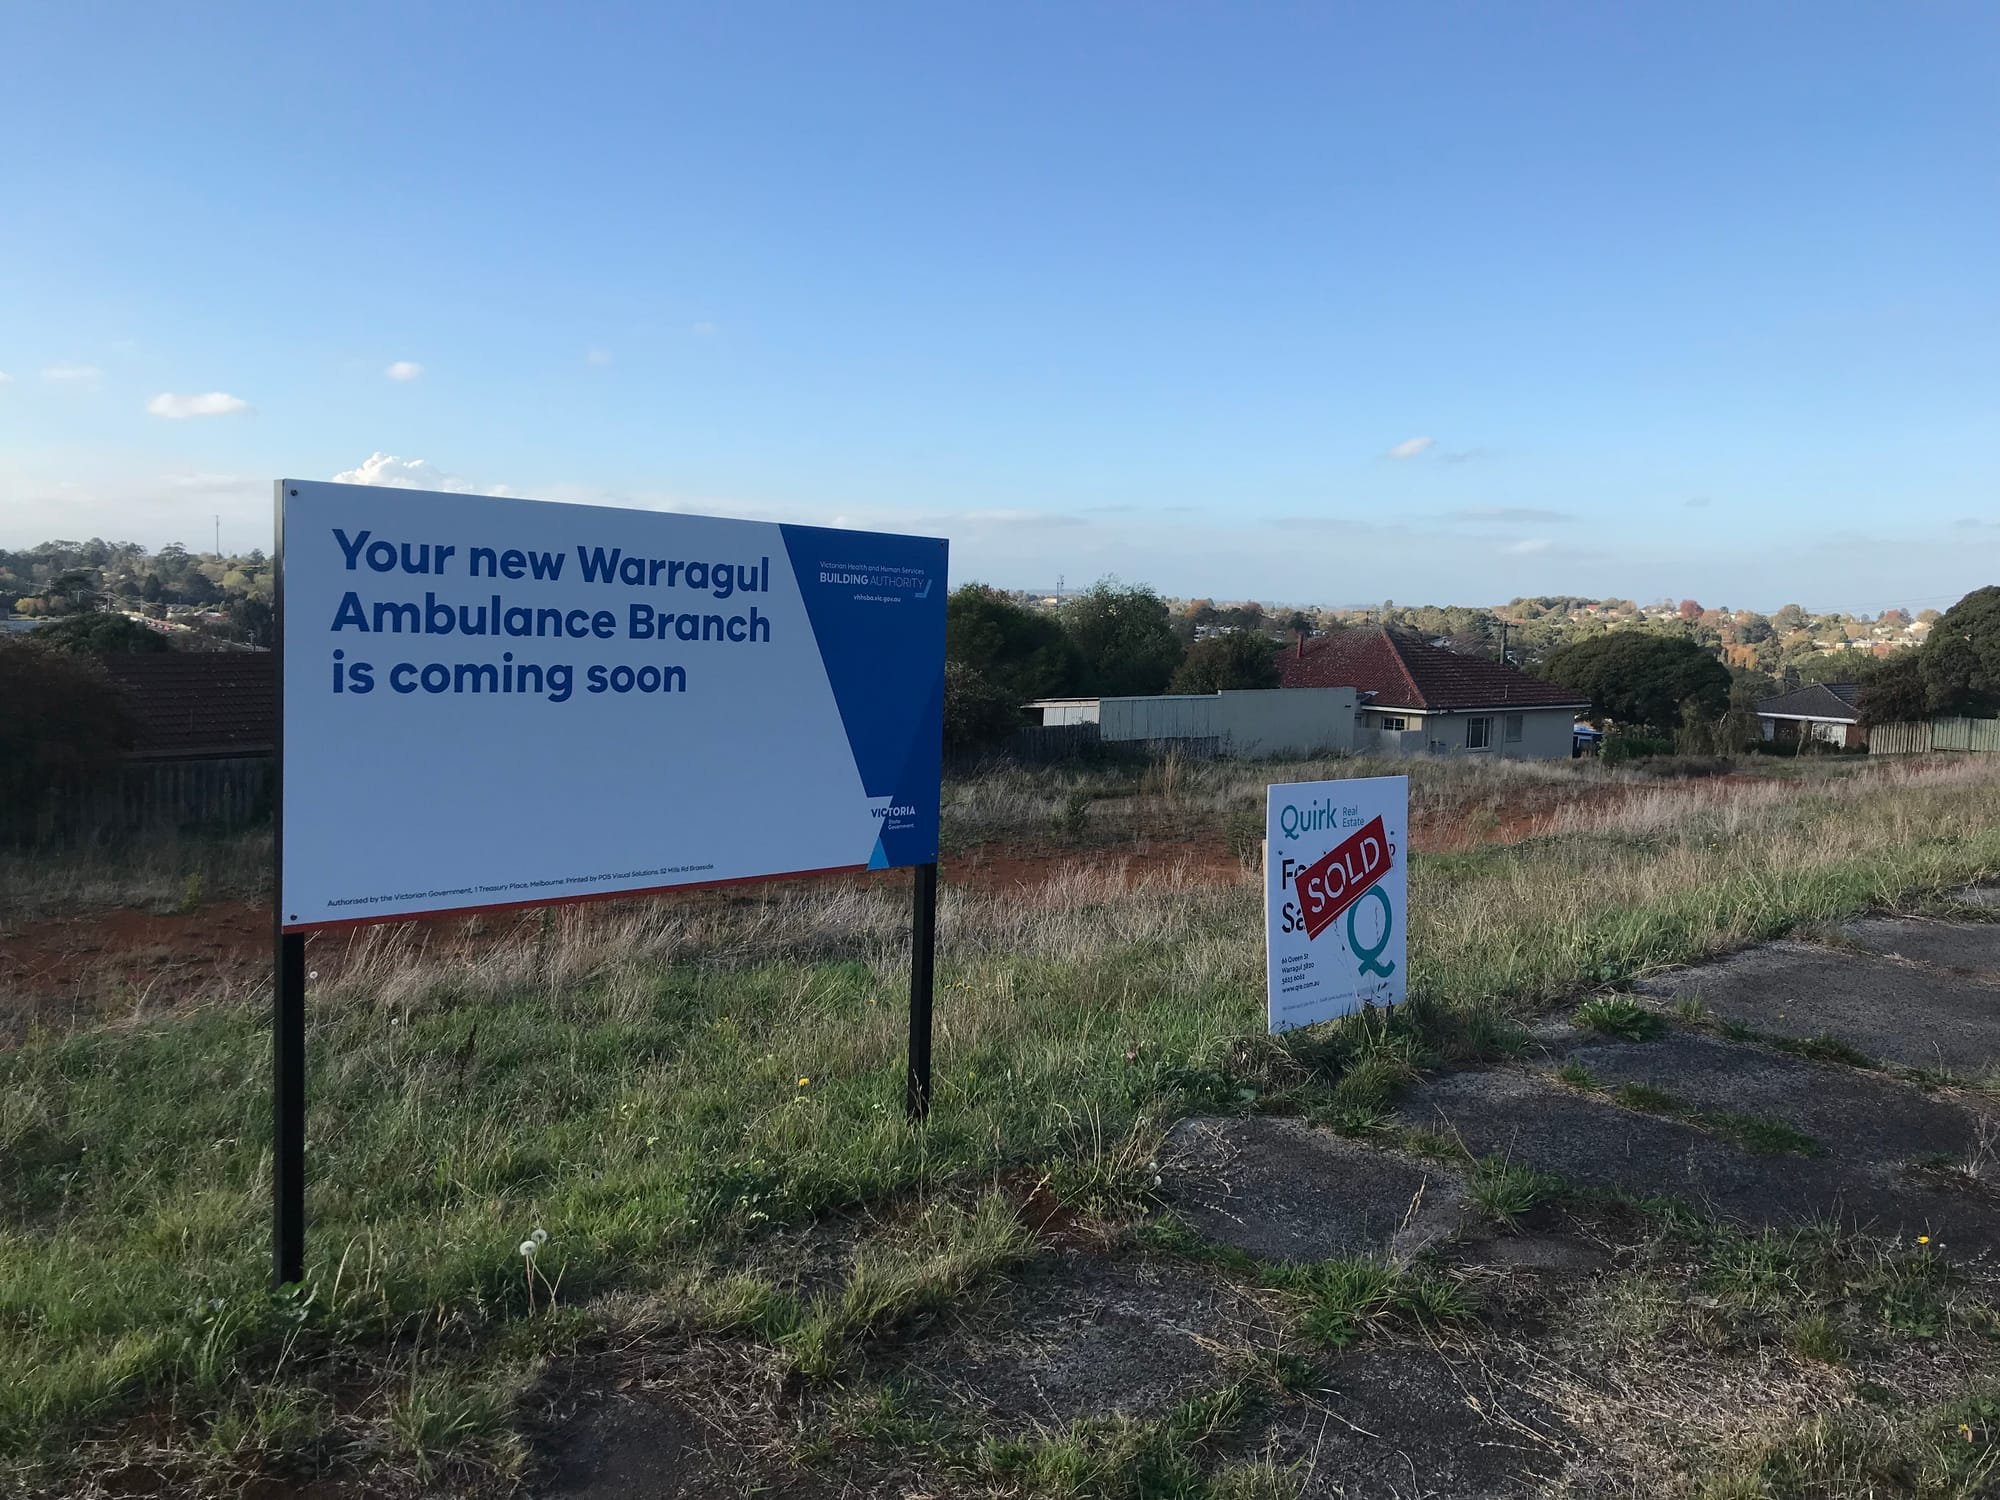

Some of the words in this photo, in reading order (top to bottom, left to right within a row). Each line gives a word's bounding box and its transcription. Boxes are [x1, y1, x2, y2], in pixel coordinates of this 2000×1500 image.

[332, 528, 455, 575] Your
[469, 545, 566, 582] new
[577, 545, 769, 599] Warragul
[820, 572, 869, 585] BUILDING
[870, 576, 924, 588] AUTHORITY
[868, 565, 879, 573] and
[330, 591, 617, 639] Ambulance
[628, 603, 771, 643] Branch
[332, 648, 376, 694] is
[389, 651, 574, 703] coming
[586, 663, 687, 693] soon
[871, 805, 916, 818] VICTORIA
[1280, 798, 1338, 841] Quirk
[1342, 805, 1359, 817] Real
[1342, 817, 1366, 828] Estate
[327, 897, 369, 907] Authorised
[369, 896, 379, 904] by
[394, 891, 428, 901] Victorian
[478, 883, 509, 893] Treasury
[589, 874, 598, 883] by
[1306, 836, 1381, 914] SOLD
